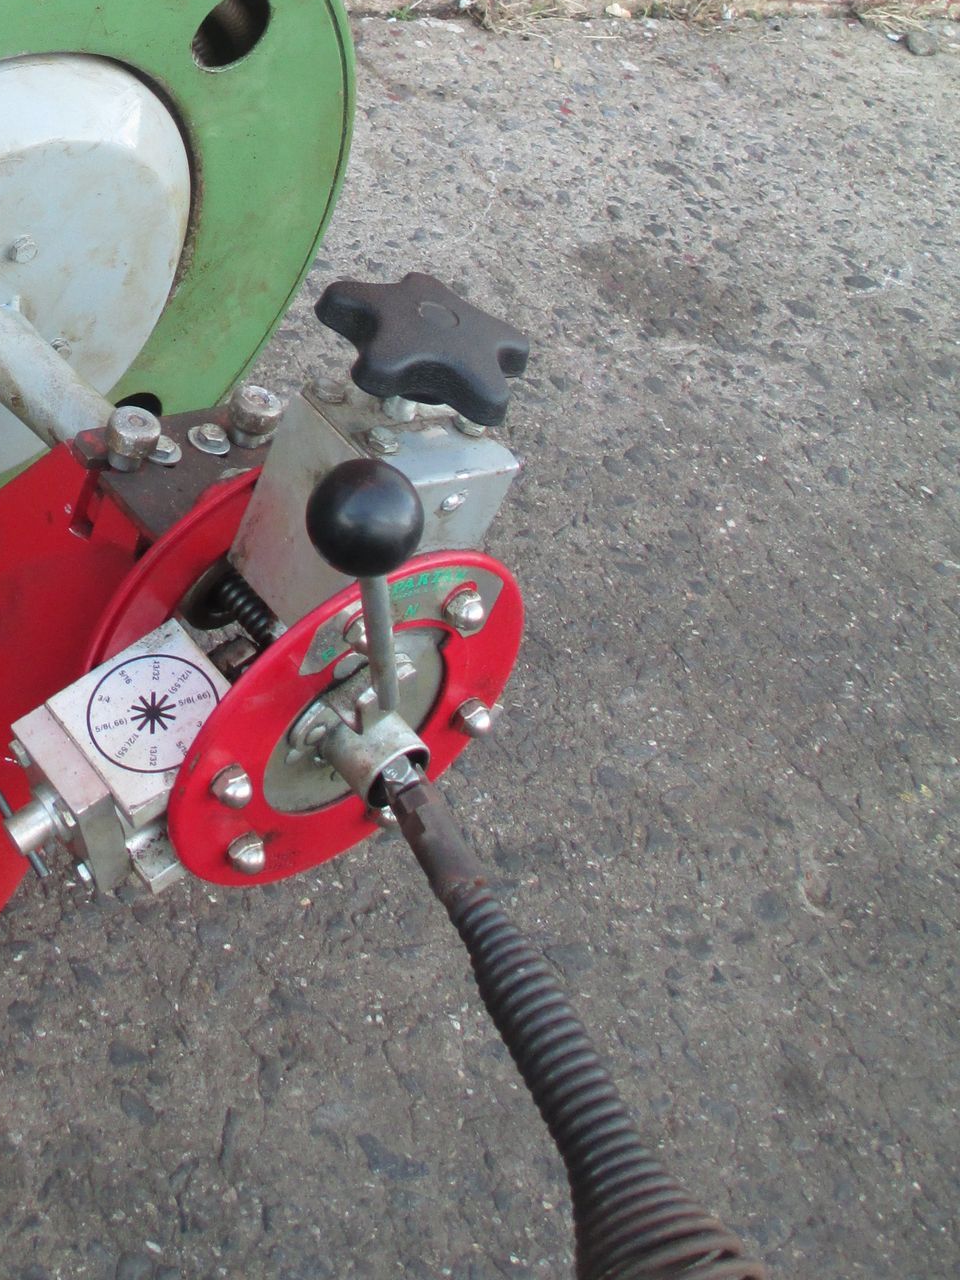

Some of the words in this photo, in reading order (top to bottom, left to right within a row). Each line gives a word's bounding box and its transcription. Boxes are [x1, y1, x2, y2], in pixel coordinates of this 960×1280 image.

[391, 568, 468, 594] PARTAN
[118, 670, 132, 685] 5/16
[152, 660, 160, 681] 13/32
[98, 694, 111, 704] 3/4
[149, 746, 158, 766] 13/32
